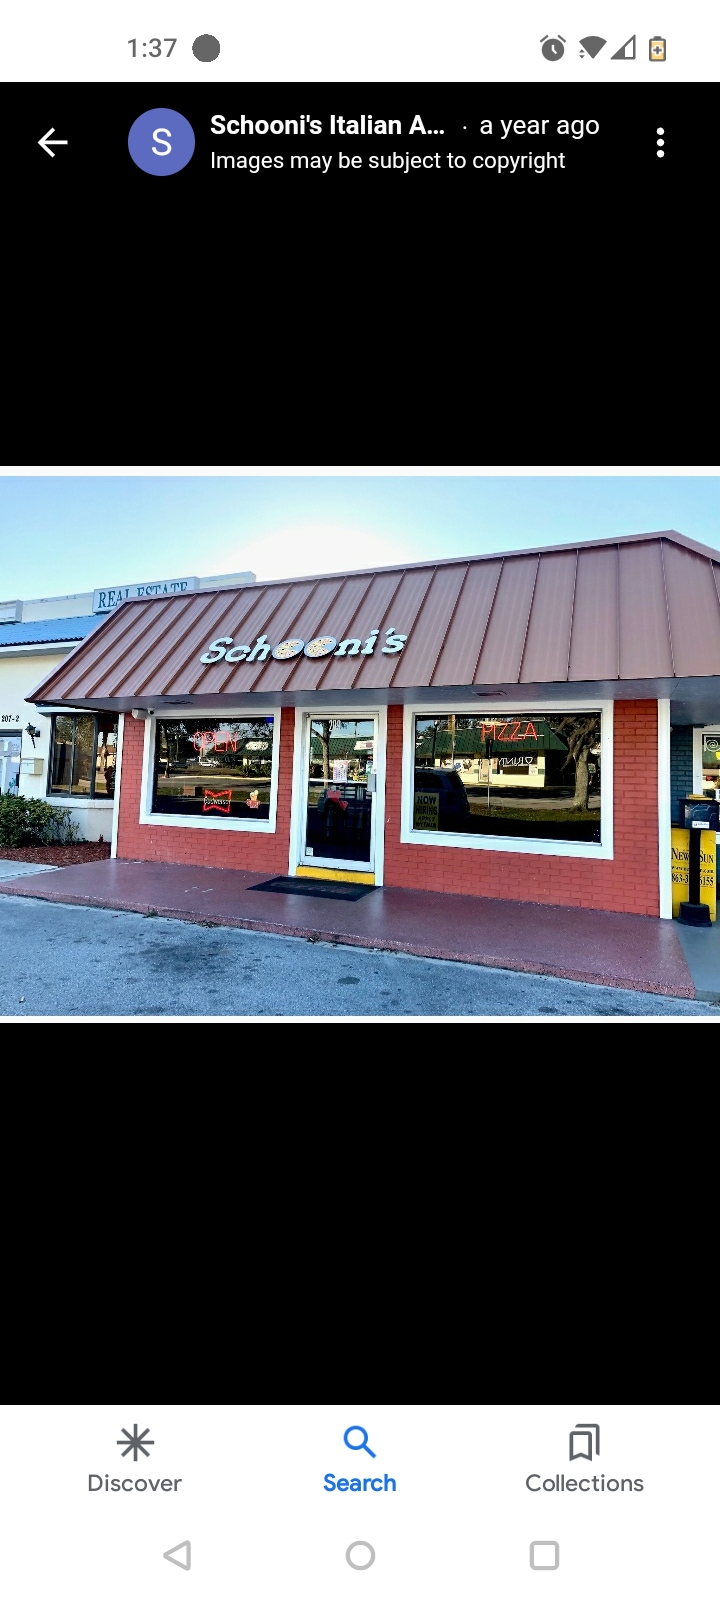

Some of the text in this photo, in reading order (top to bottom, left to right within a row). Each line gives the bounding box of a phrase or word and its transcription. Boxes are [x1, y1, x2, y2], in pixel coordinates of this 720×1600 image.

[128, 39, 176, 57] 1:37
[211, 115, 322, 134] Schooni's
[331, 115, 401, 134] Italian
[480, 120, 492, 134] a
[500, 120, 549, 139] year
[557, 120, 599, 139] ago
[152, 129, 171, 155] S
[211, 152, 565, 173] Images may be subject to copyright
[98, 588, 130, 608] REAL
[199, 627, 408, 665] Schooni's
[1, 714, 20, 723] 207-2
[481, 721, 538, 742] PIZZA
[193, 731, 238, 752] OPEN
[417, 796, 436, 805] NOW
[415, 805, 438, 816] HIRING
[89, 1474, 182, 1491] Discover
[324, 1474, 396, 1491] Search
[526, 1474, 643, 1491] Collections
